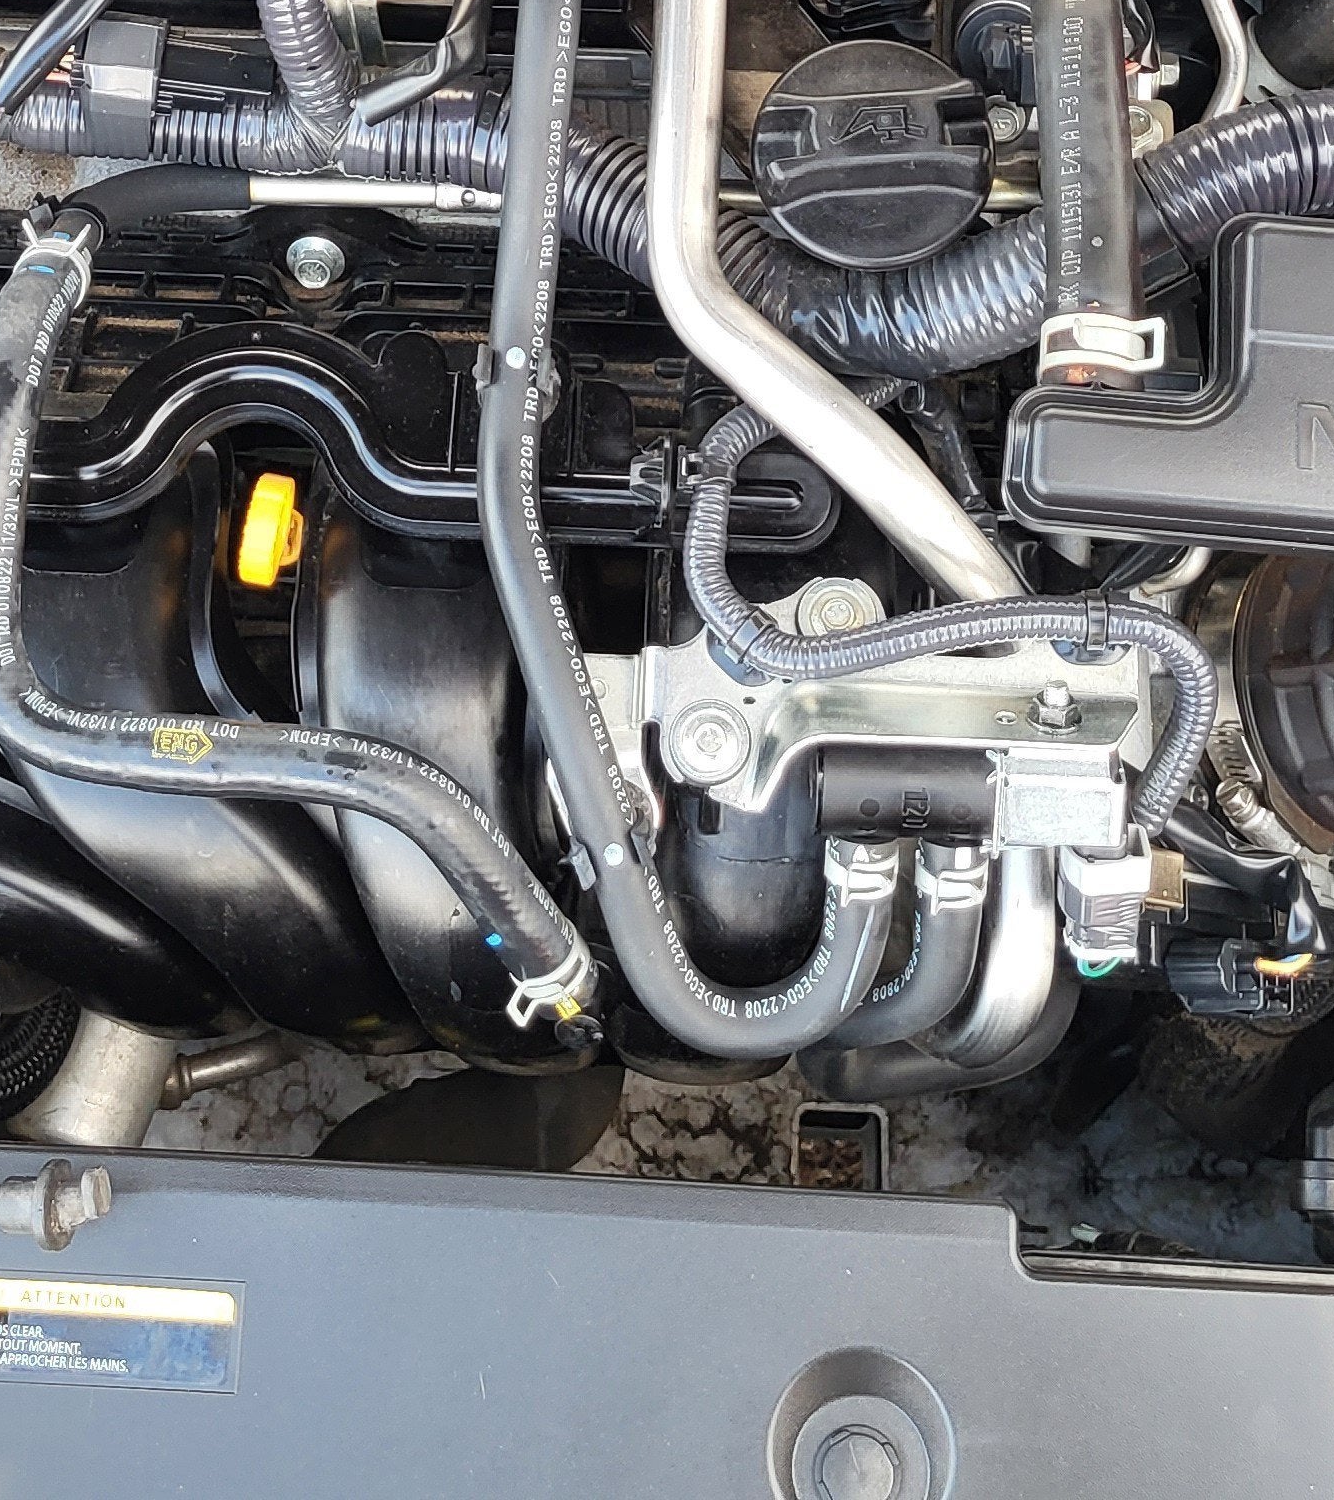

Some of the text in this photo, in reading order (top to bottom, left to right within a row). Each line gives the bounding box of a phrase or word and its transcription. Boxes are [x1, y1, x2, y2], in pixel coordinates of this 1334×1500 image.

[521, 433, 554, 584] TRD>ECO<2208
[539, 117, 563, 269] TRD>ECO<2208
[26, 355, 44, 387] DOT
[8, 427, 29, 488] >EPDM<
[0, 490, 22, 553] 11/32VL
[160, 732, 198, 754] ENG
[20, 1289, 126, 1308] ATTENTION
[0, 1353, 66, 1368] APPROCHER
[68, 1357, 87, 1369] LES
[89, 1358, 129, 1372] MAINS.
